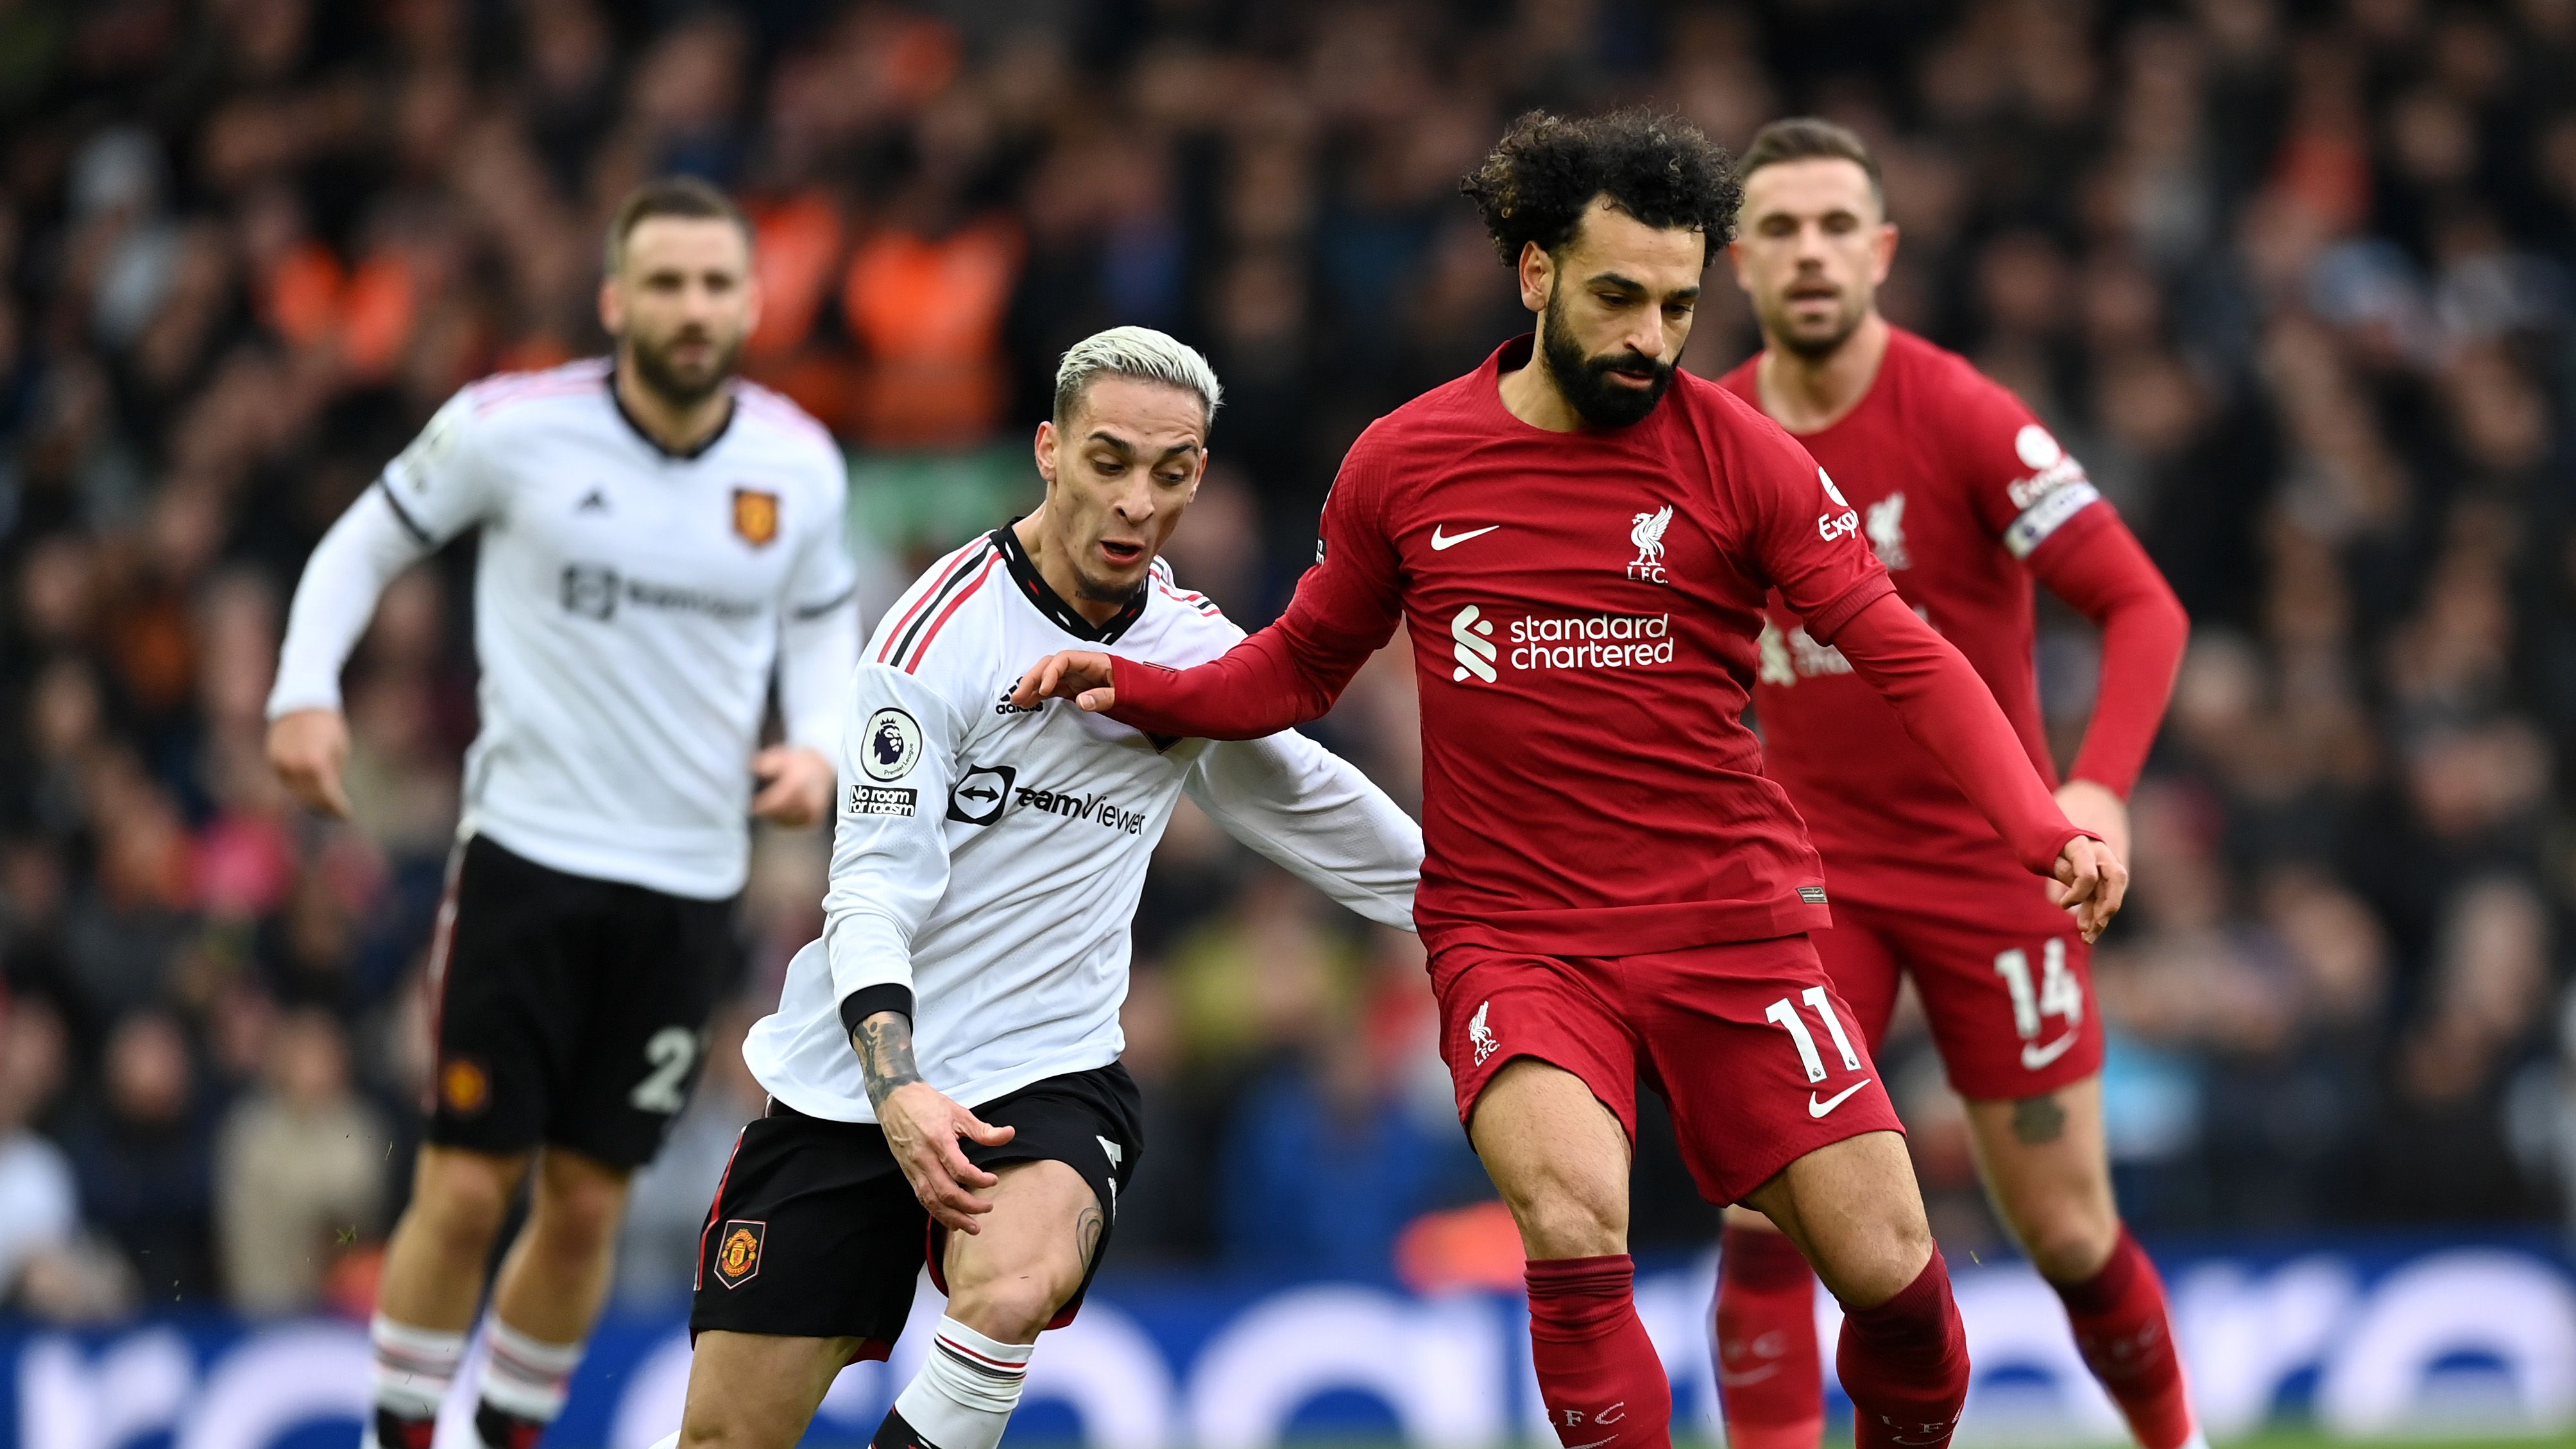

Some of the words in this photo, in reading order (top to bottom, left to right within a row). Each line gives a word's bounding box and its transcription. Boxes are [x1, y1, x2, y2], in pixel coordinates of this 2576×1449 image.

[1510, 612, 1669, 643] standard
[1511, 637, 1674, 669] chartered
[852, 785, 869, 800] No
[871, 789, 910, 803] room
[867, 802, 916, 816] racism
[1993, 937, 2083, 1040] 14
[1765, 986, 1862, 1084] 11
